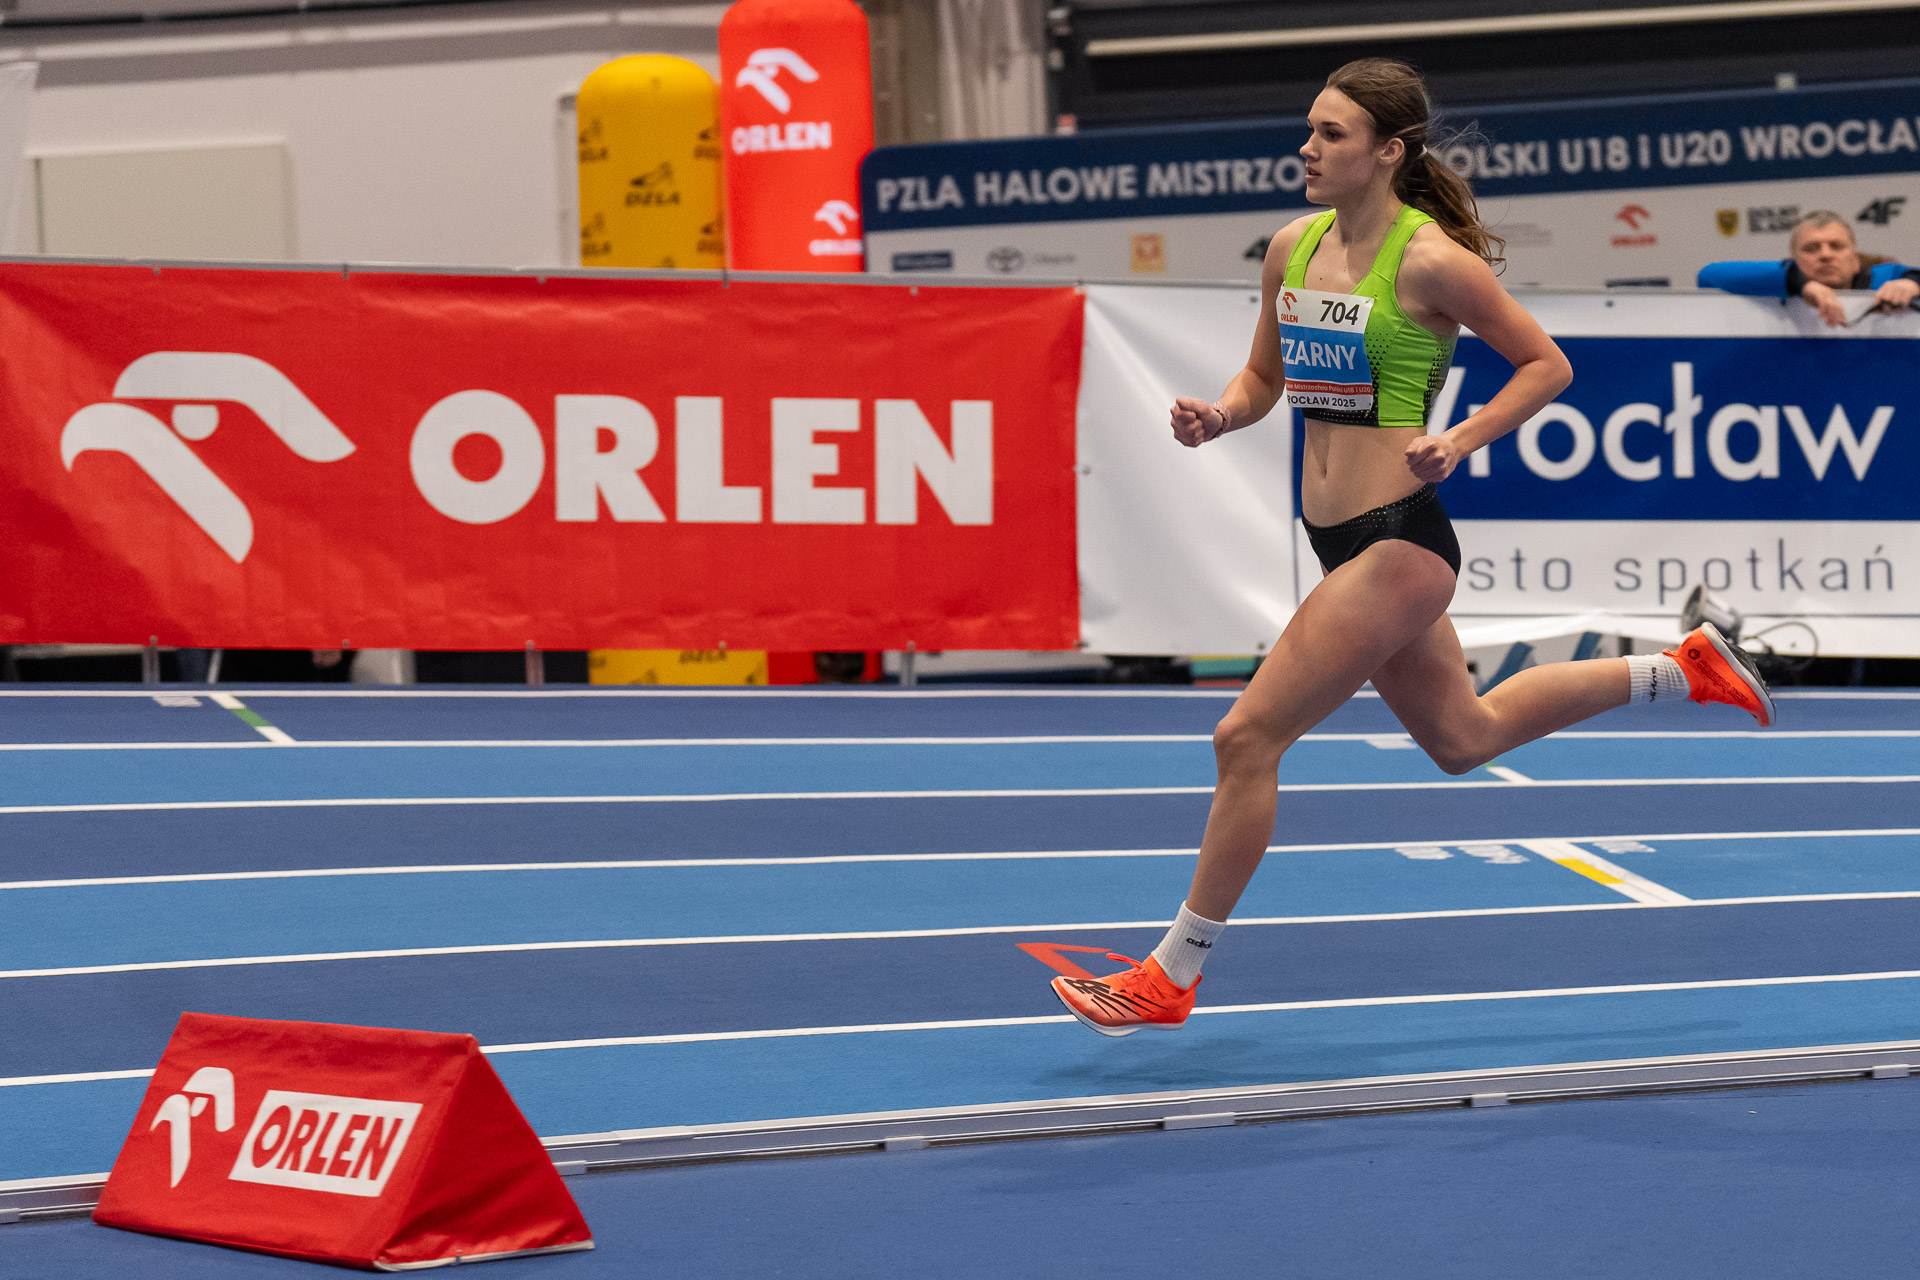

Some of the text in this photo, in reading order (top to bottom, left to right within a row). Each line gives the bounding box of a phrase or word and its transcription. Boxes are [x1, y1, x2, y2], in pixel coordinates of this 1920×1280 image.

[732, 121, 831, 155] ORLEN
[876, 174, 964, 212] PZLA
[974, 164, 1138, 206] HALOWE
[1558, 136, 1632, 174] U18
[1658, 128, 1732, 168] U20
[1740, 116, 1920, 161] WROCŁA
[1281, 313, 1298, 323] ORLEN
[1320, 300, 1360, 325] 704
[1332, 397, 1356, 407] 2025
[410, 389, 993, 525] ORLEN
[1614, 538, 1893, 604] spotkań
[252, 1105, 404, 1181] ORLEN
